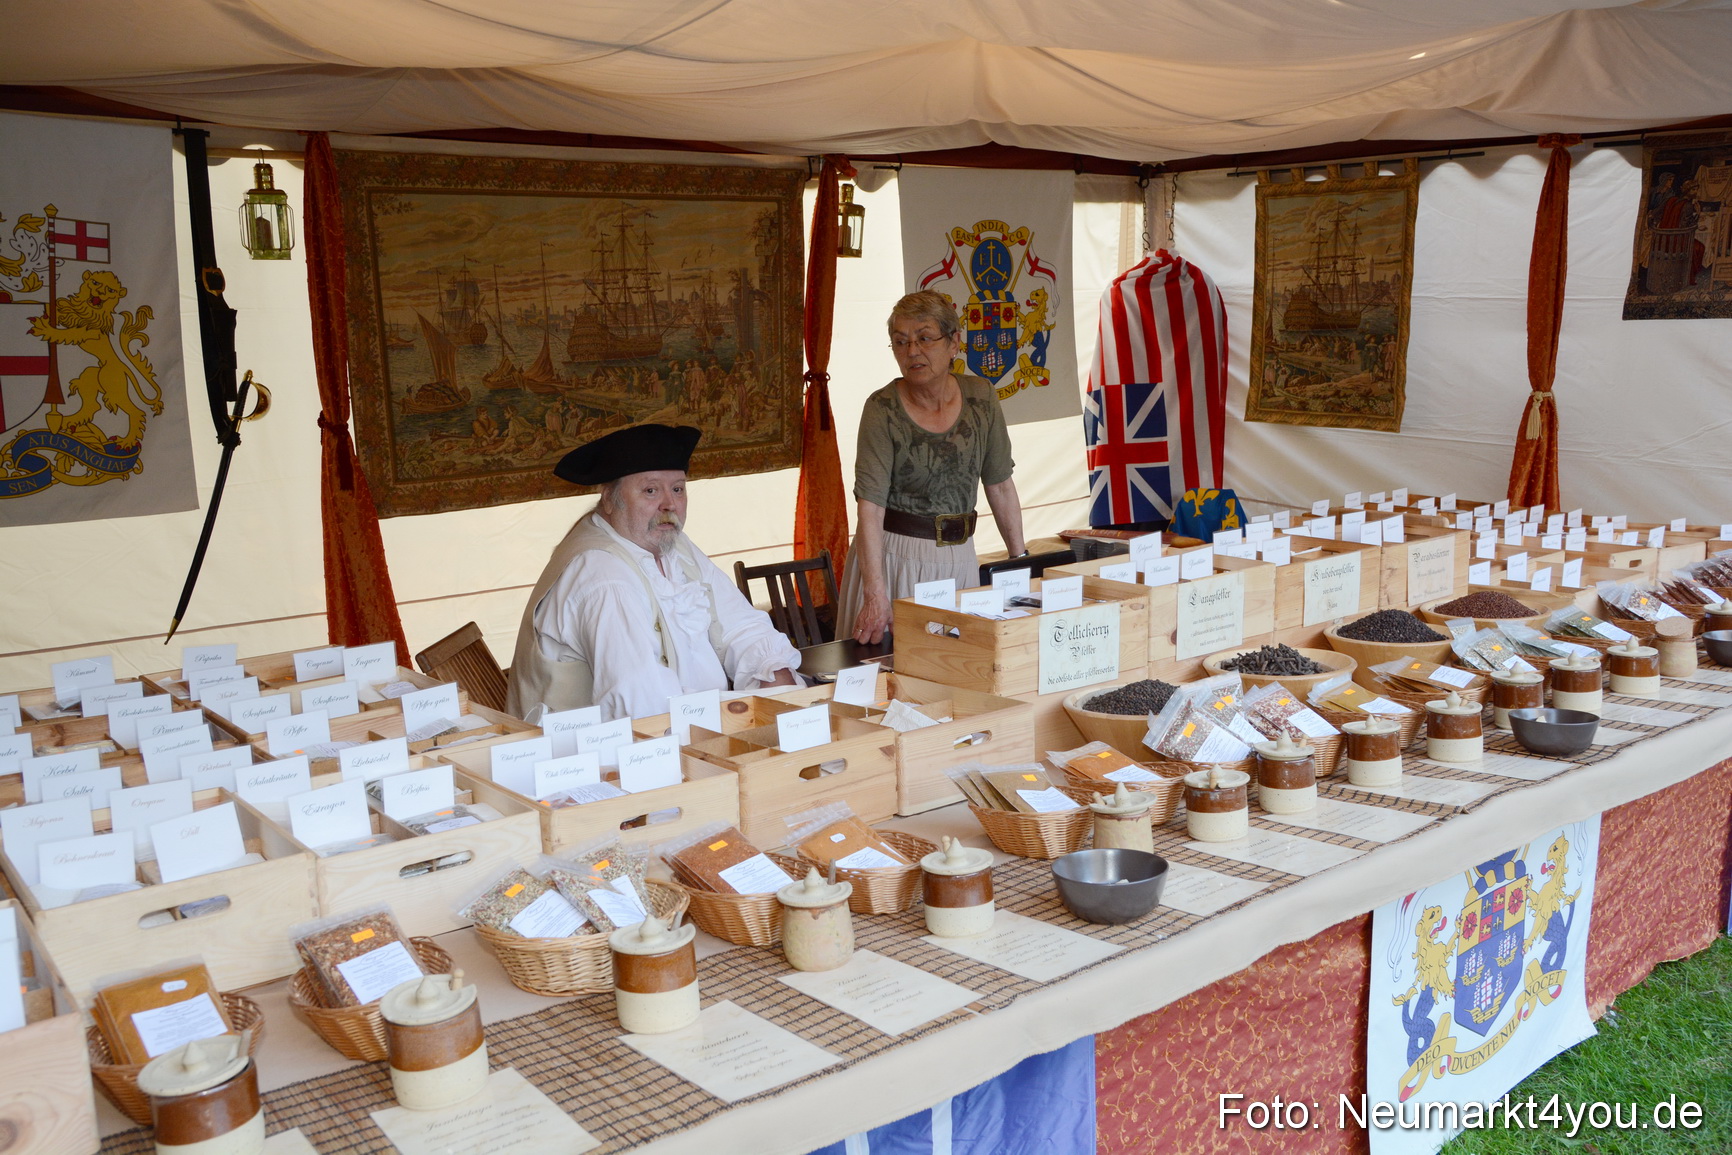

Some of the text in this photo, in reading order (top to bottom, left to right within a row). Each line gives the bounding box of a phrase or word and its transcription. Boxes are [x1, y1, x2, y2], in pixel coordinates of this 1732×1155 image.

[956, 230, 975, 244] EAST
[977, 221, 1005, 233] INDIA
[1020, 368, 1044, 378] NOCET
[29, 434, 128, 471] ATUS ANGLIAE
[8, 478, 38, 494] SEN
[1050, 619, 1110, 648] Tellicherry
[194, 654, 222, 665] Paprika
[305, 658, 334, 669] Cayenne
[351, 655, 382, 667] Ingwer
[66, 667, 97, 678] Kümmel
[845, 675, 865, 687] Curry
[312, 694, 350, 706] Senfkörner
[410, 696, 450, 711] Pfeffer grün
[680, 703, 706, 717] Curry
[283, 726, 308, 737] Pfeffer
[656, 747, 671, 757] Chili
[351, 753, 391, 768] Liebstöckel
[43, 764, 78, 777] Kerbel
[248, 771, 298, 788] Salatkräuter
[63, 785, 94, 798] Salbei
[131, 797, 166, 809] Oregano
[302, 799, 347, 816] Estragon
[23, 816, 64, 828] Majoran
[180, 826, 201, 840] Dill
[53, 850, 116, 865] Bohnenkraut
[1416, 971, 1562, 1073] DEO DVCENTE NIL NOCET
